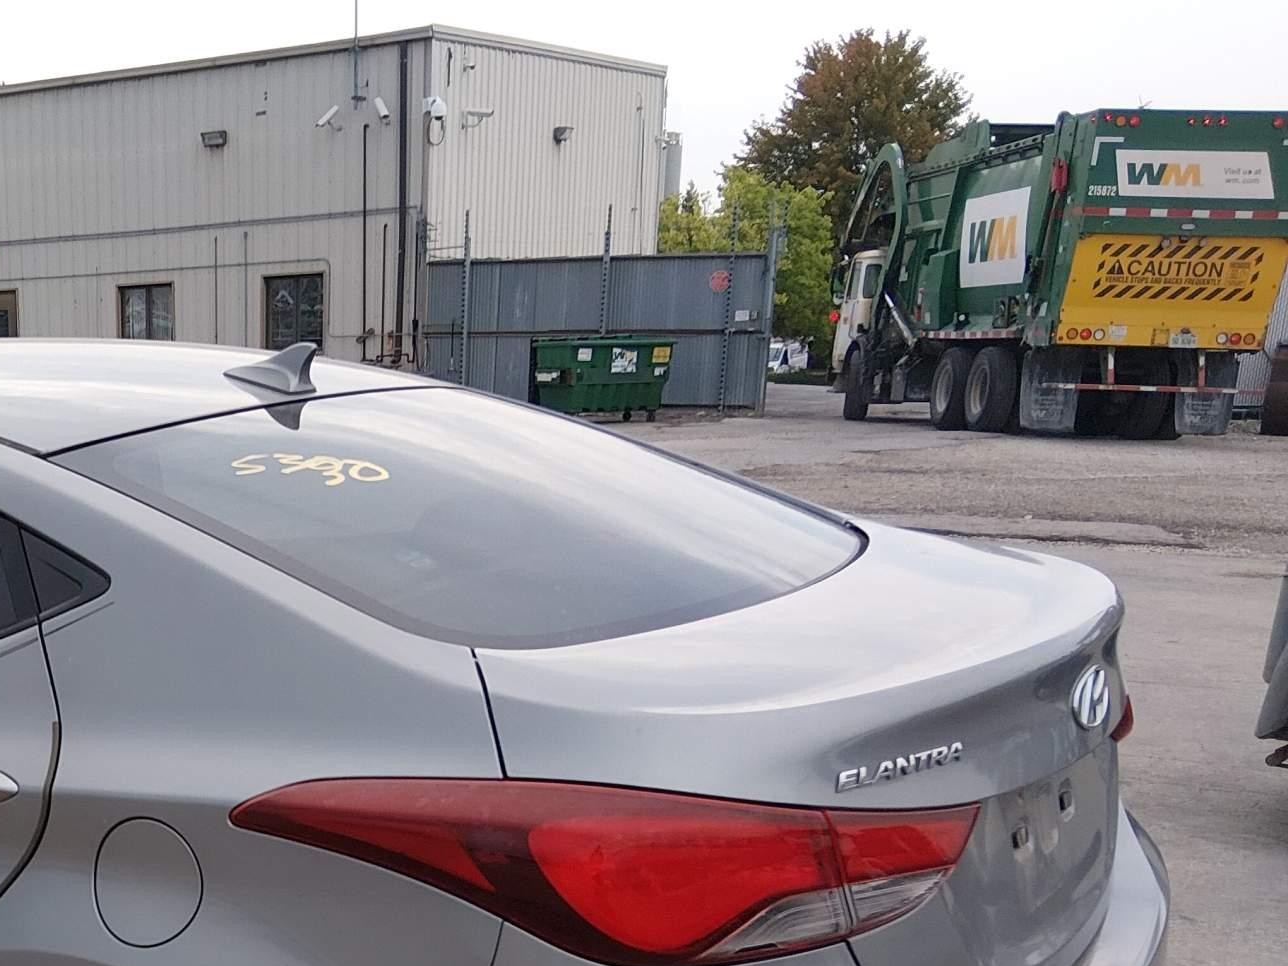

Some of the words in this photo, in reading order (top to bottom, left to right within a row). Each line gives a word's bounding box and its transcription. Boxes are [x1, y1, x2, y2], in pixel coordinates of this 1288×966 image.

[1127, 162, 1200, 187] WM
[1087, 184, 1117, 197] 215872
[968, 215, 1017, 264] WM
[1127, 260, 1225, 278] CAUTION
[835, 741, 963, 793] ELANTRA
